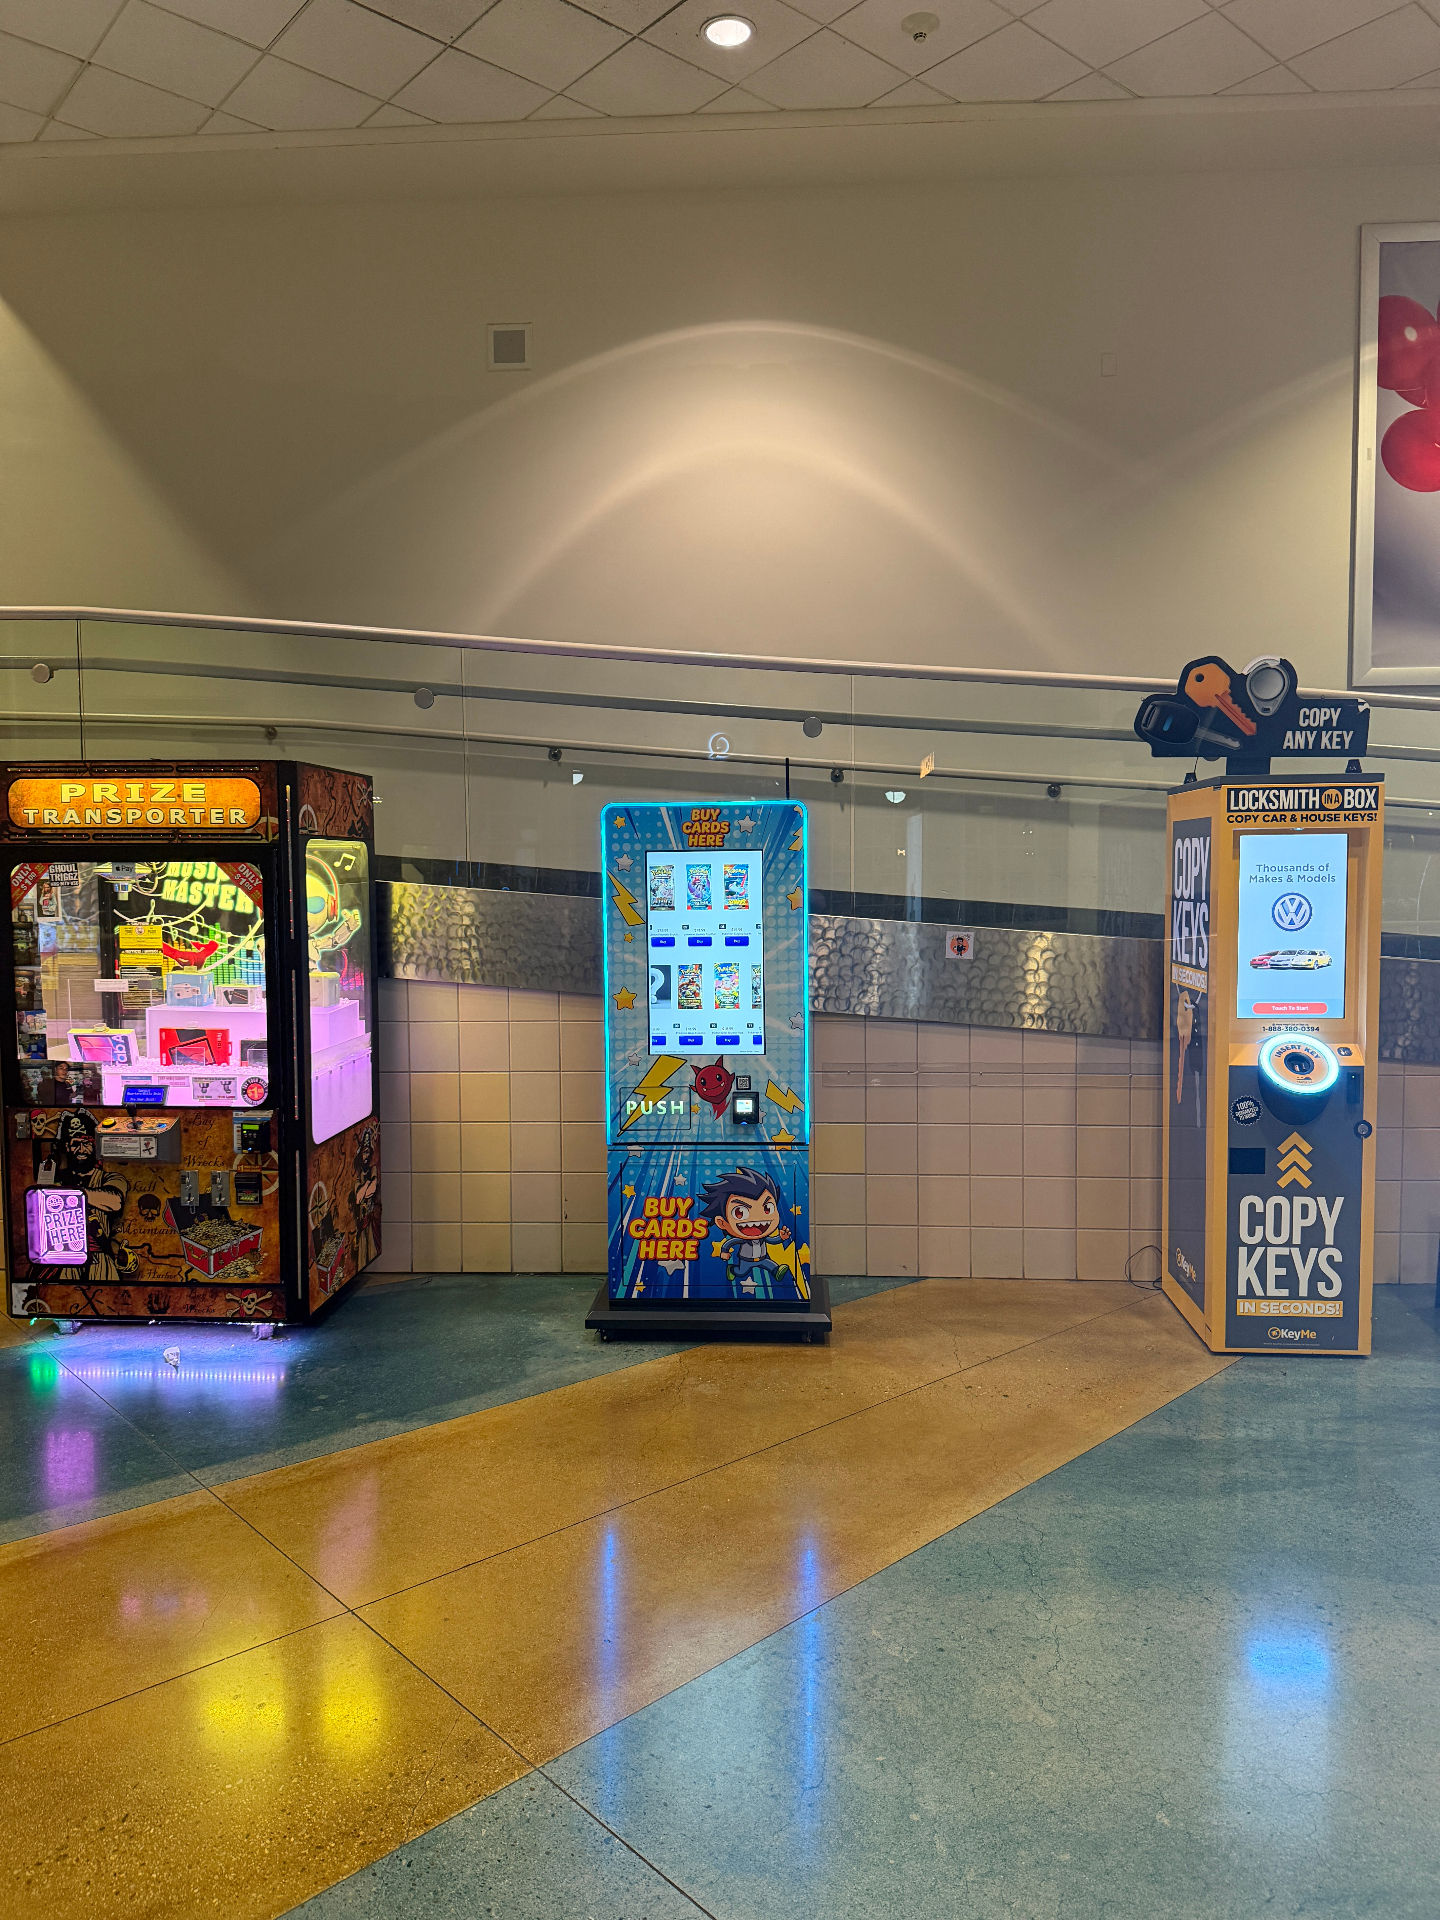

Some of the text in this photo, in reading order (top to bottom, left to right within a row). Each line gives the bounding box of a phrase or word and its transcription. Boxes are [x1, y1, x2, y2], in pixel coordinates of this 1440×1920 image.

[1299, 707, 1342, 727] COPY
[1283, 730, 1354, 750] ANY KEY
[60, 783, 207, 803] PRIZE
[1230, 787, 1377, 811] LOCKSMITH IN A BOX
[23, 808, 248, 825] TRANSPORTER
[690, 808, 721, 821] BUY
[1227, 813, 1378, 824] COPY CAR & HOUSE KEYS!
[682, 820, 731, 834] CARDS
[688, 834, 724, 848] HERE
[11, 863, 32, 887] ONLY
[49, 863, 78, 874] GHOUL
[49, 872, 79, 882] TRIGGZ
[238, 863, 262, 887] ONLY
[1174, 836, 1211, 900] COPY
[1256, 862, 1330, 873] Thousands of
[1249, 873, 1336, 884] Makes & Models
[1172, 901, 1209, 968] KEYS
[1275, 1044, 1321, 1059] INSERT KEY
[626, 1100, 684, 1115] PUSH
[188, 1112, 216, 1131] Bay
[184, 1155, 226, 1168] Wrecks
[644, 1196, 695, 1218] BUY
[44, 1209, 84, 1229] PRIZE
[1239, 1195, 1345, 1246] COPY
[50, 1224, 85, 1245] HERE
[628, 1218, 708, 1240] CARDS
[638, 1239, 699, 1260] HERE
[1237, 1247, 1343, 1298] KEYS
[1239, 1301, 1340, 1316] IN SECONDS!
[1281, 1328, 1317, 1341] KeyMe
